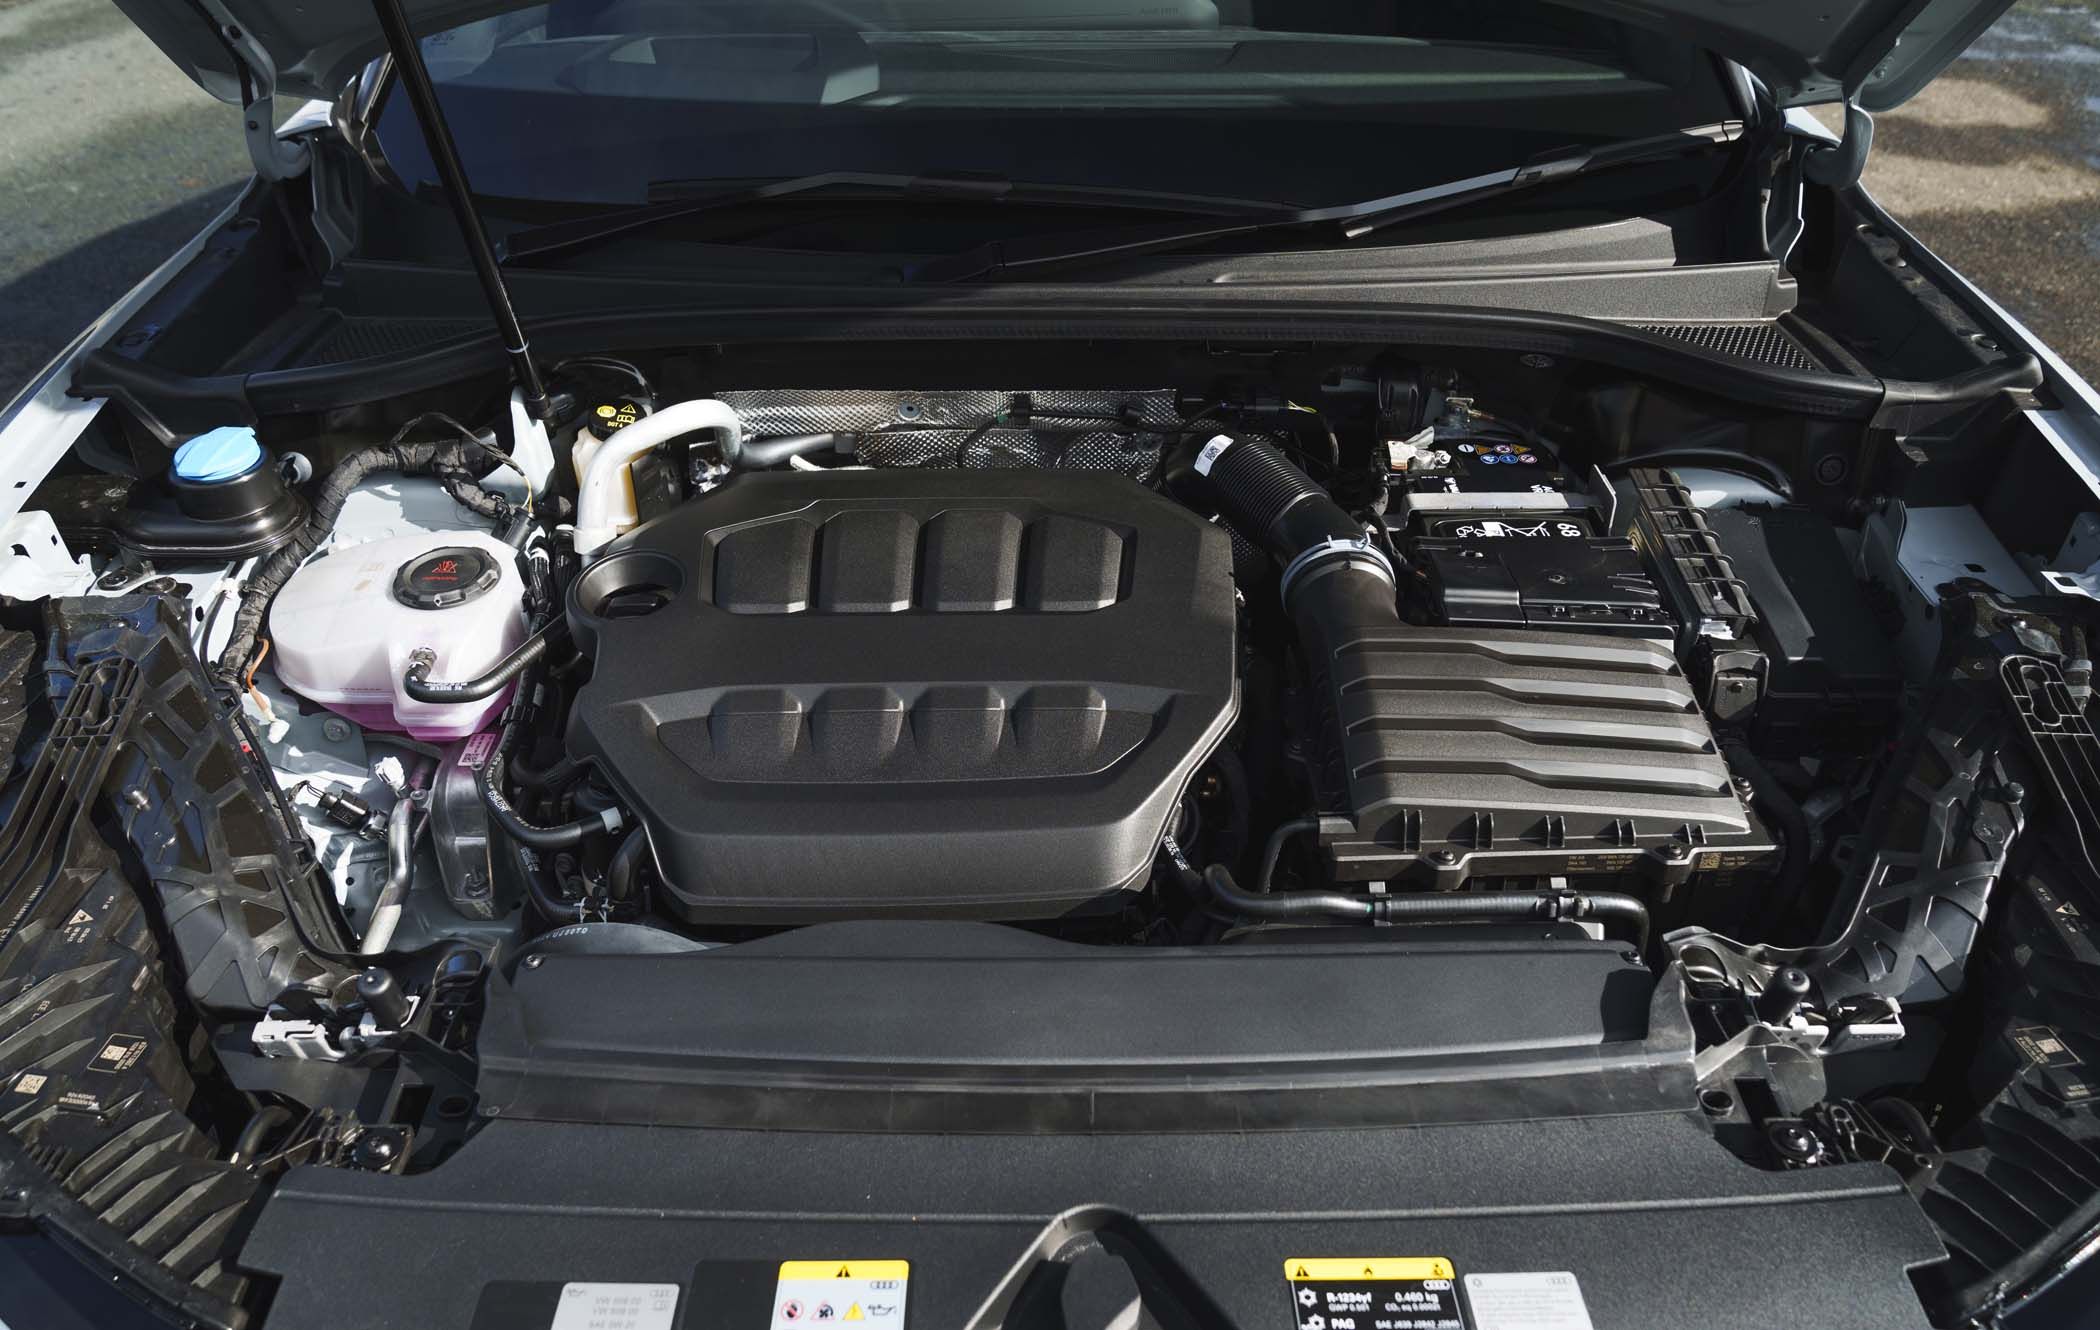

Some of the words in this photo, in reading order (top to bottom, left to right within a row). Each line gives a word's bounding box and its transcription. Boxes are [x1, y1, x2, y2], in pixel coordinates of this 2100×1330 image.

[1556, 523, 1582, 537] 68
[1424, 1292, 1440, 1304] kg
[1331, 1318, 1356, 1330] PAG
